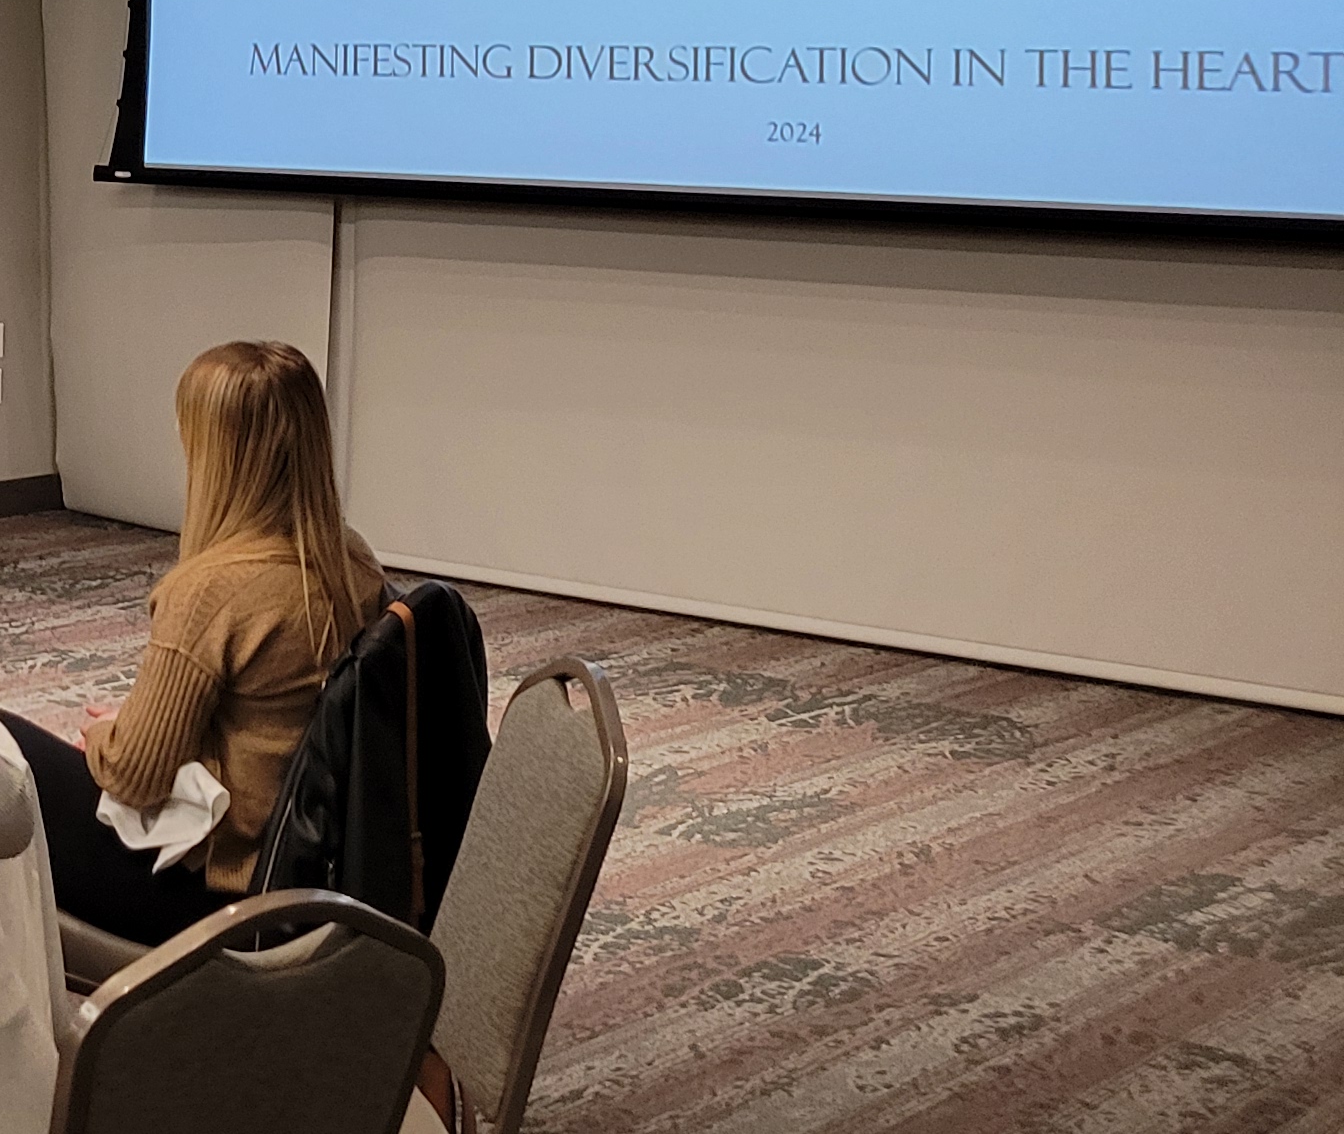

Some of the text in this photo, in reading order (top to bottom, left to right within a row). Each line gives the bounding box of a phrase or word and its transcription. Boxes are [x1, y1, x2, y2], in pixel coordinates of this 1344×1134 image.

[249, 42, 513, 79] MANIFESTING
[527, 44, 934, 86] DIVERSIFICATION
[952, 48, 1006, 87] IN
[1024, 49, 1133, 89] THE
[766, 121, 822, 145] 2024
